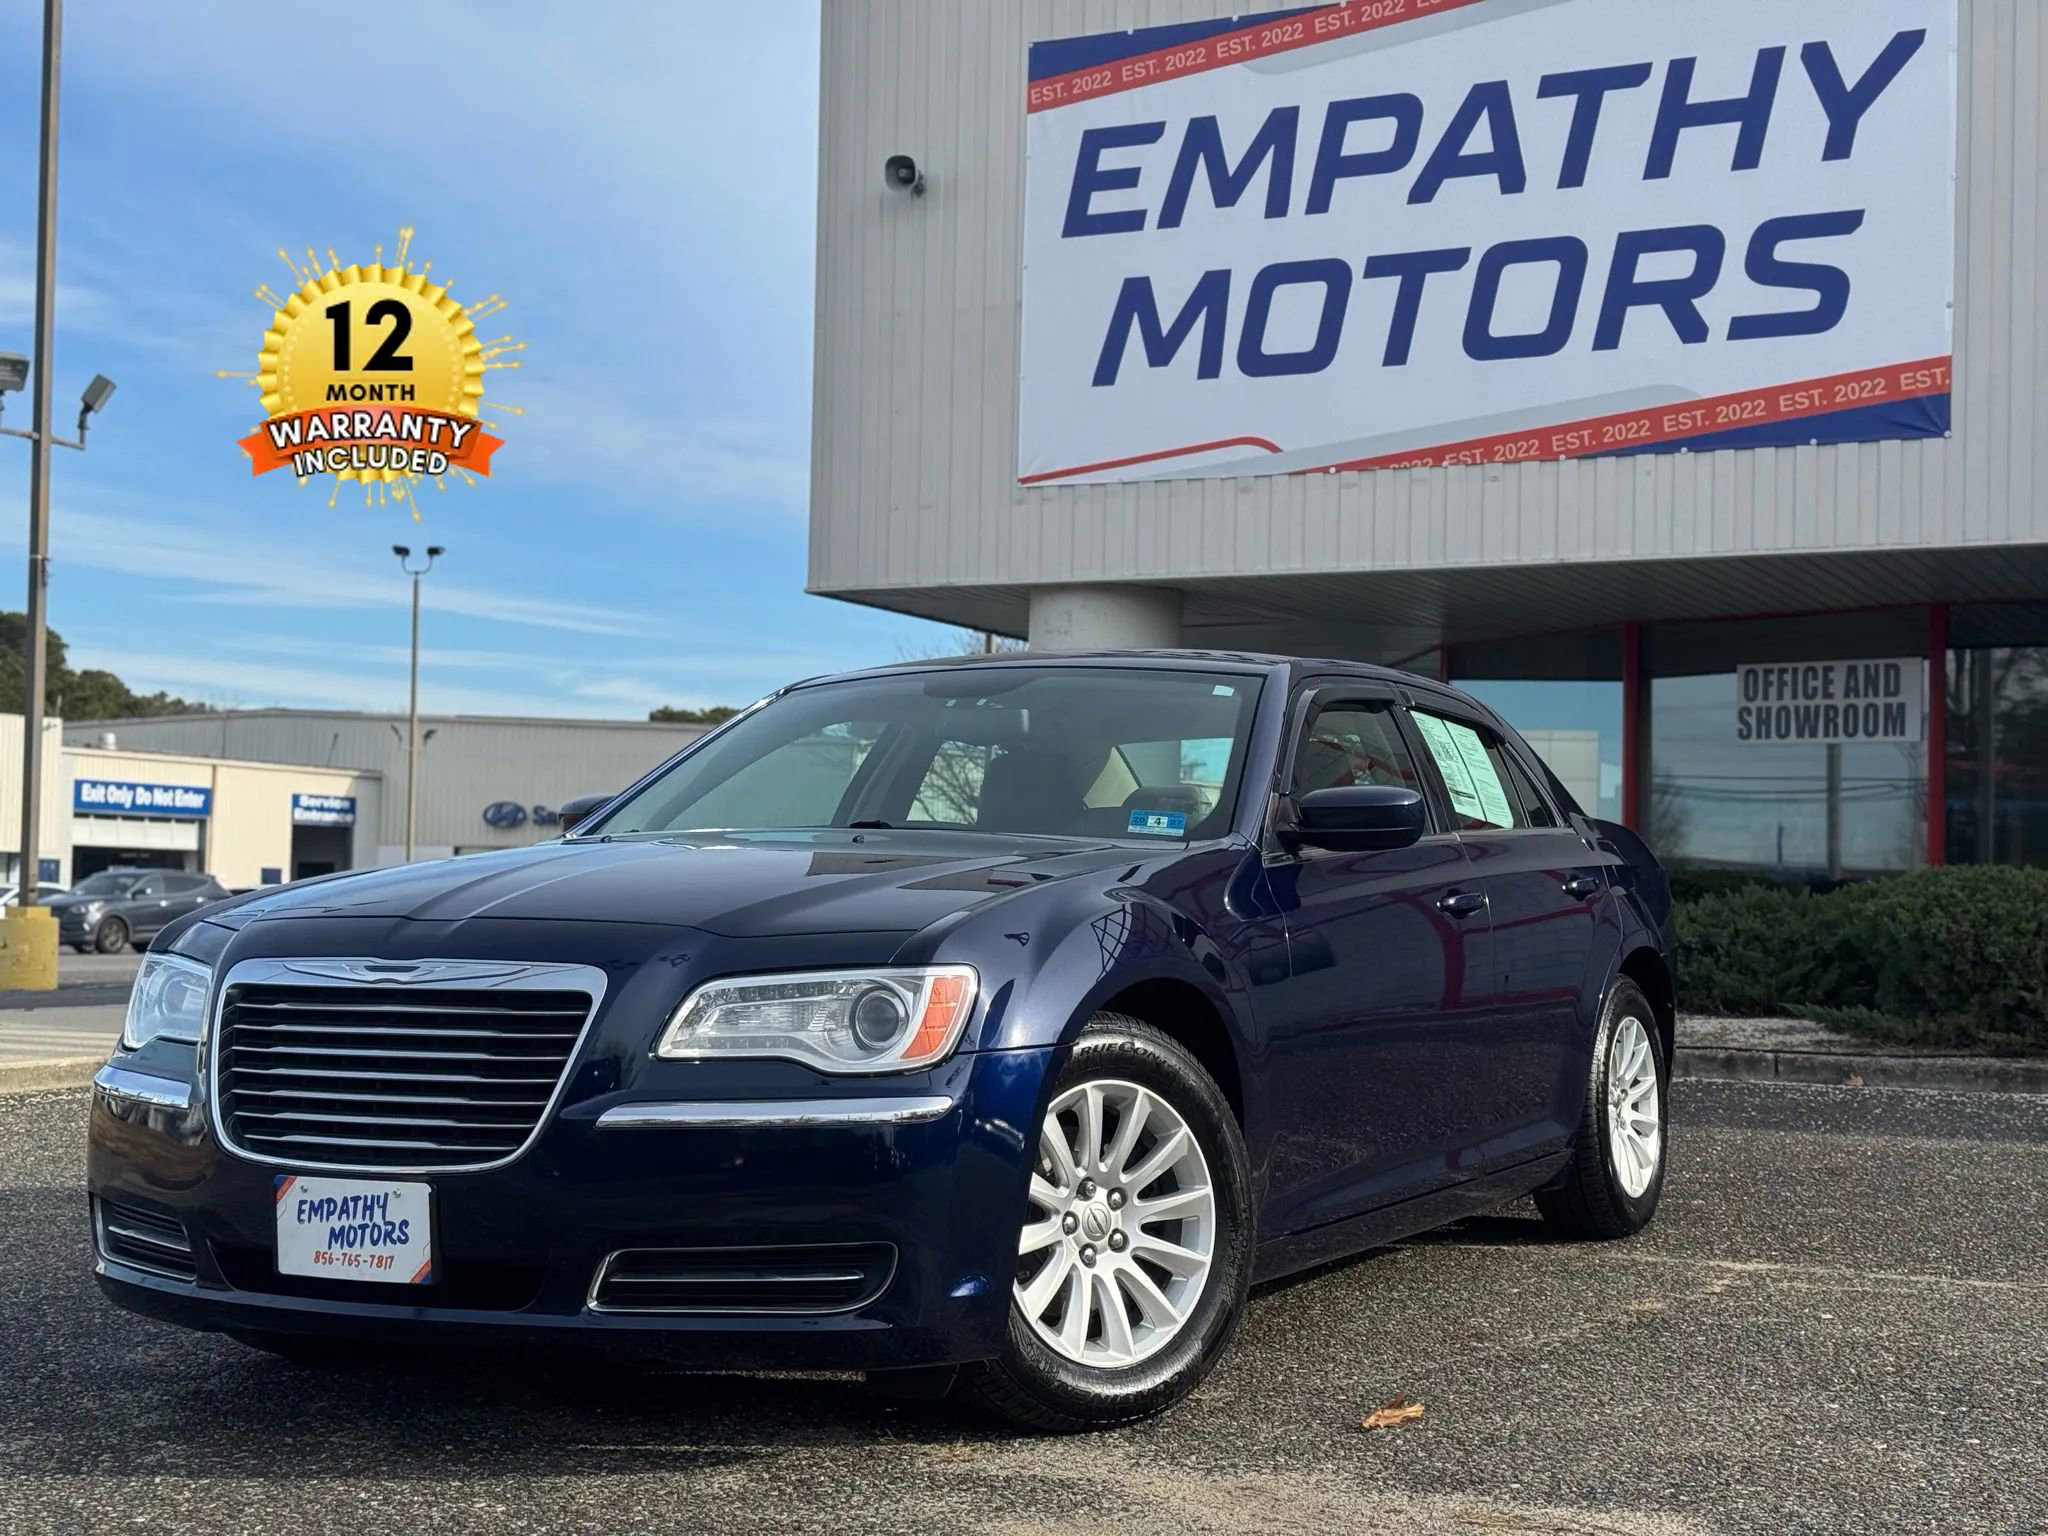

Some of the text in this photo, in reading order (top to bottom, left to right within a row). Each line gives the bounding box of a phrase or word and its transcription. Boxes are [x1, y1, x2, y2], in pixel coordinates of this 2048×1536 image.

[1031, 0, 1405, 104] EST. 2022 EST. 2022 EST. 2022 EST. 2022
[1062, 29, 1927, 239] EMPATHY
[1091, 209, 1866, 387] MOTORS
[1494, 440, 1540, 462] 2022
[1551, 430, 1597, 451] EST.
[1602, 420, 1651, 443] 2022
[1663, 410, 1709, 433] EST.
[1715, 399, 1766, 423] 2022
[1779, 388, 1827, 412] EST.
[1834, 378, 1887, 403] 2022
[1899, 367, 1950, 391] EST.
[1743, 662, 1901, 703] OFFICE AND
[1737, 702, 1907, 740] SHOWROOM
[81, 782, 206, 809] Exit Only Do Not Enter
[1154, 817, 1162, 826] 4
[297, 1192, 389, 1225] EMPATHY
[327, 1218, 410, 1251] MOTORS
[313, 1250, 395, 1270] 856-765-7817
